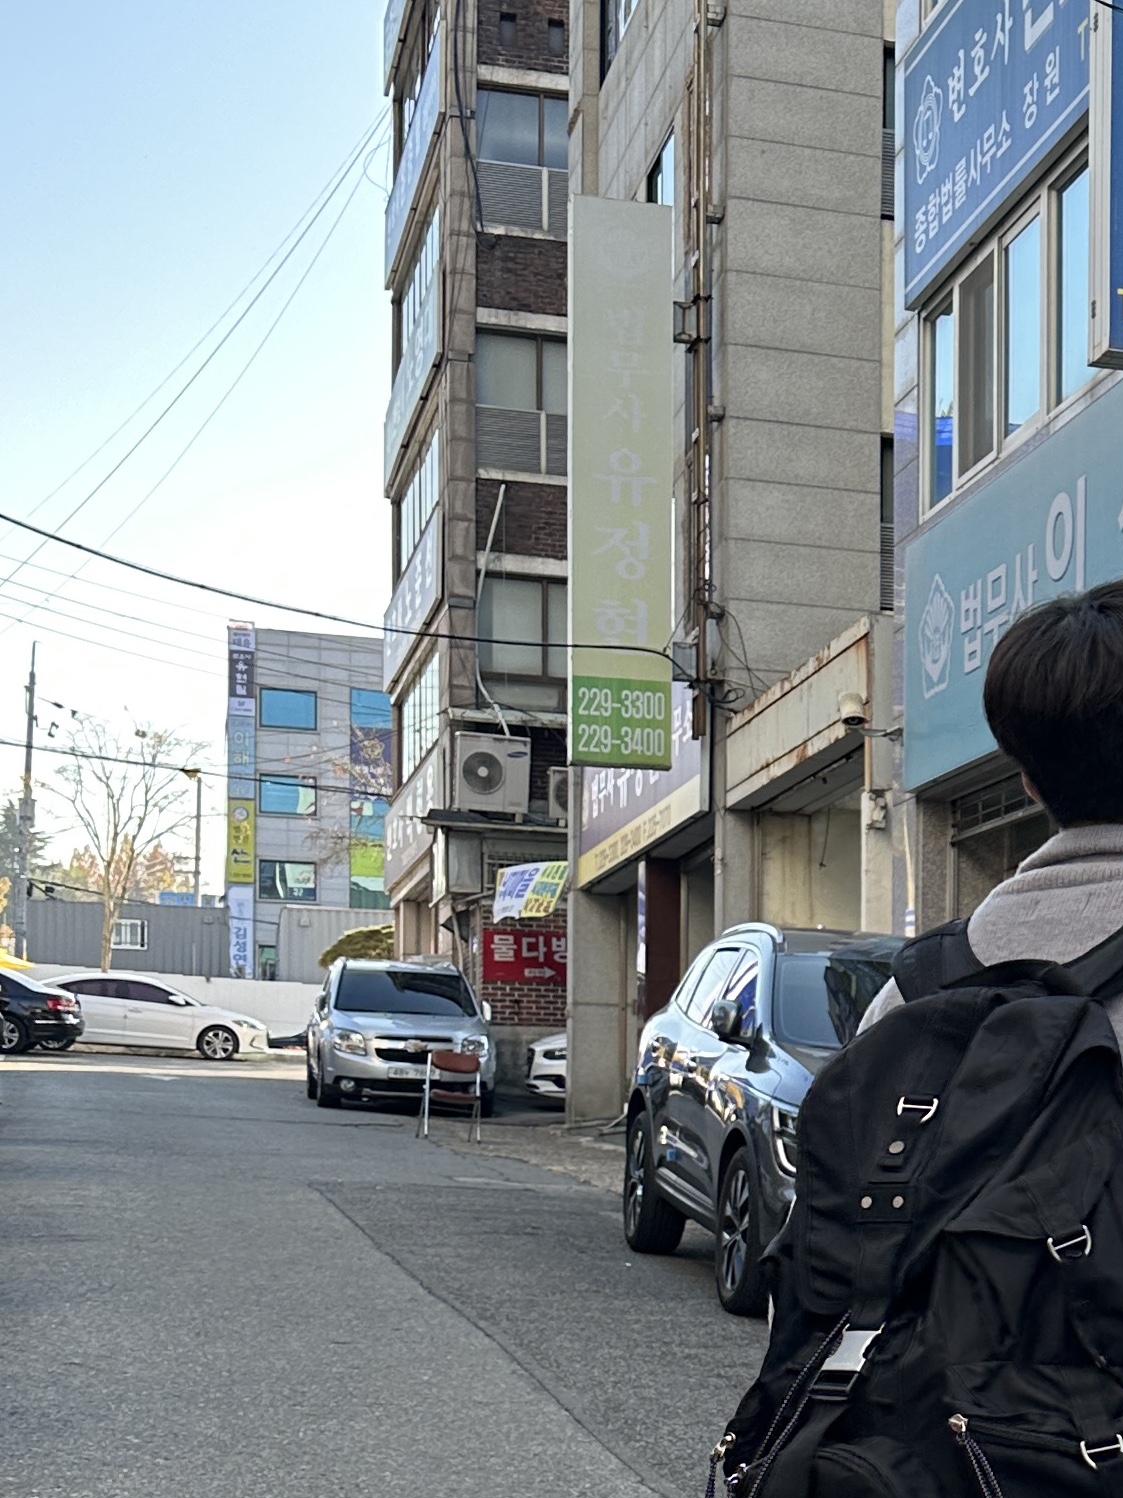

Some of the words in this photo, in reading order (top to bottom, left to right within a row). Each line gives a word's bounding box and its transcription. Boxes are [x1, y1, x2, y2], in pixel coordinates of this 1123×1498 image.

[947, 0, 1014, 123] 변호사
[914, 109, 1012, 254] 종합법률사무소
[958, 542, 1038, 676] 법무사
[577, 686, 666, 721] 229-3300
[577, 723, 666, 757] 229-3400
